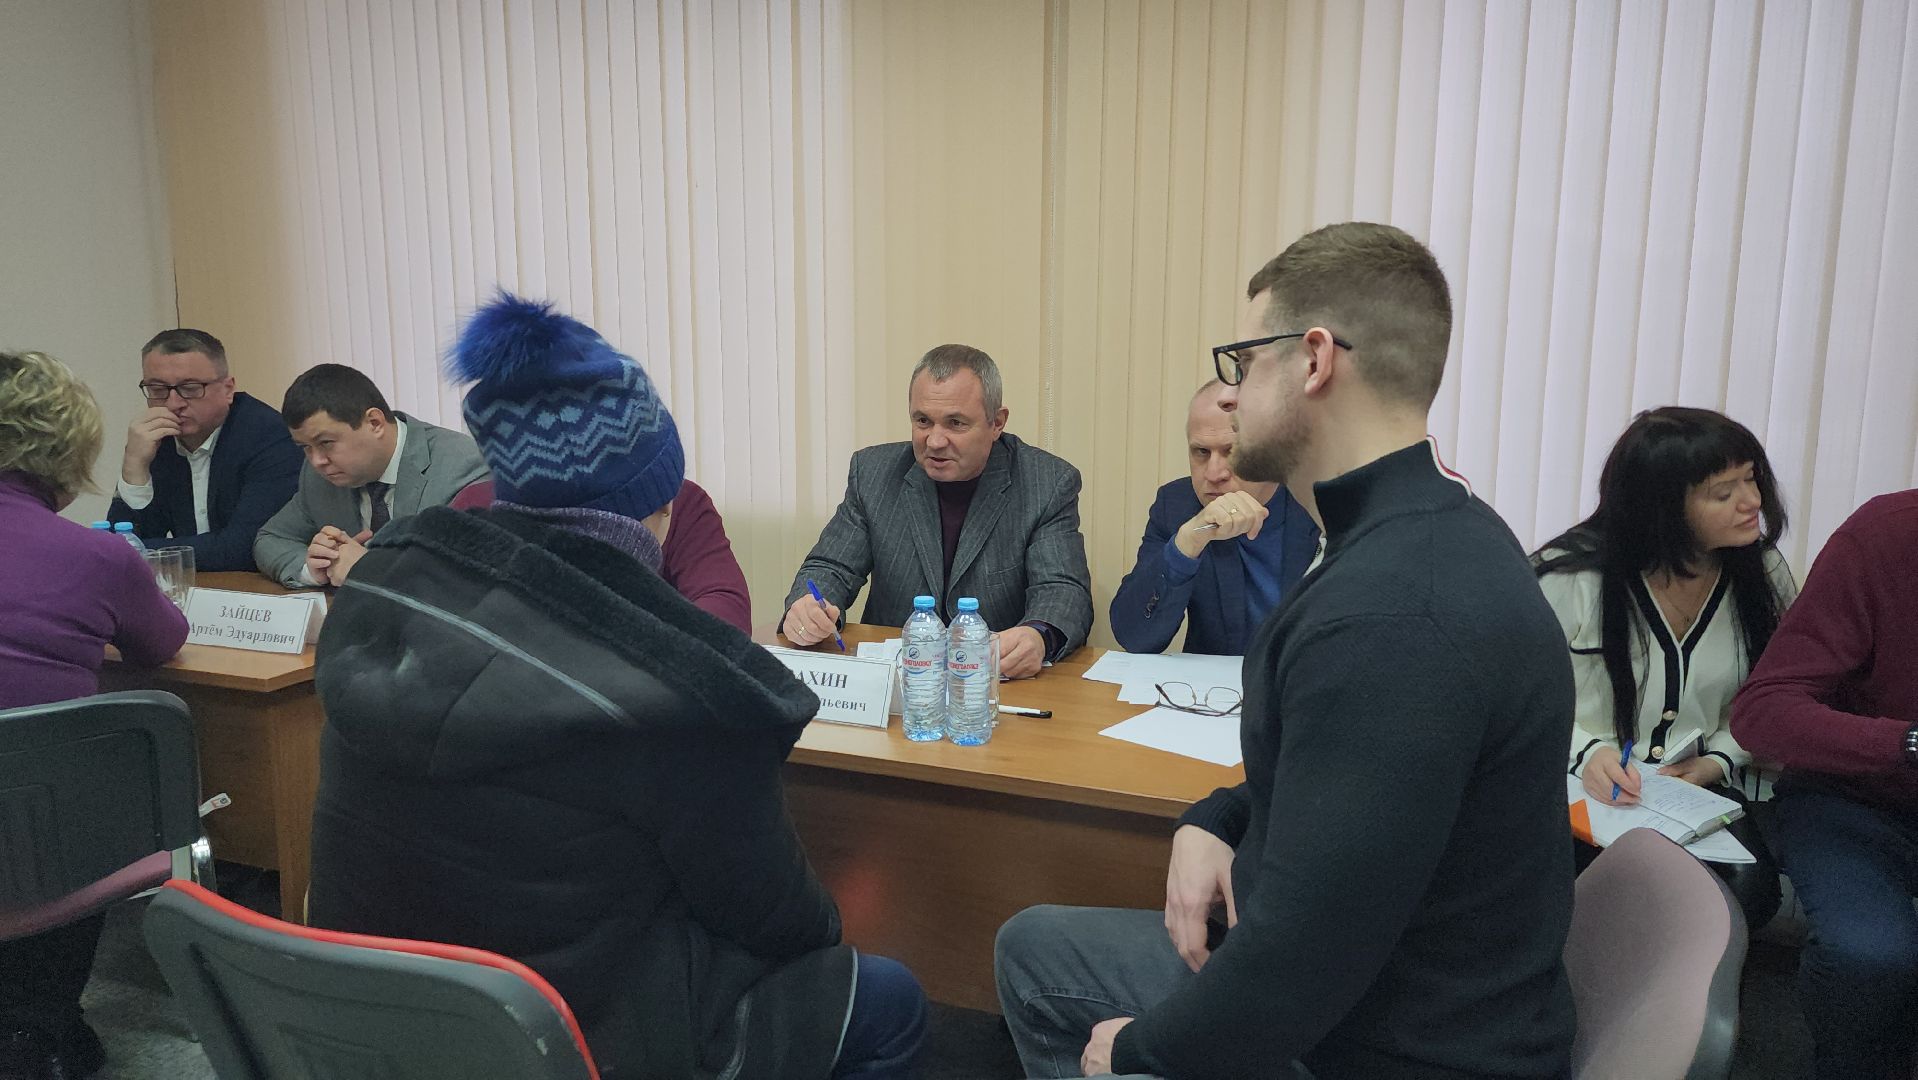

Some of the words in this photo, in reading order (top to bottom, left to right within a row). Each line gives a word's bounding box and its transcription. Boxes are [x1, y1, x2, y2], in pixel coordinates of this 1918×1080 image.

[218, 604, 273, 623] ЗАЙЦЕВ
[190, 621, 223, 637] Артём
[227, 625, 296, 645] Эдуардович
[795, 669, 849, 689] АХИН
[819, 698, 867, 712] льевич
